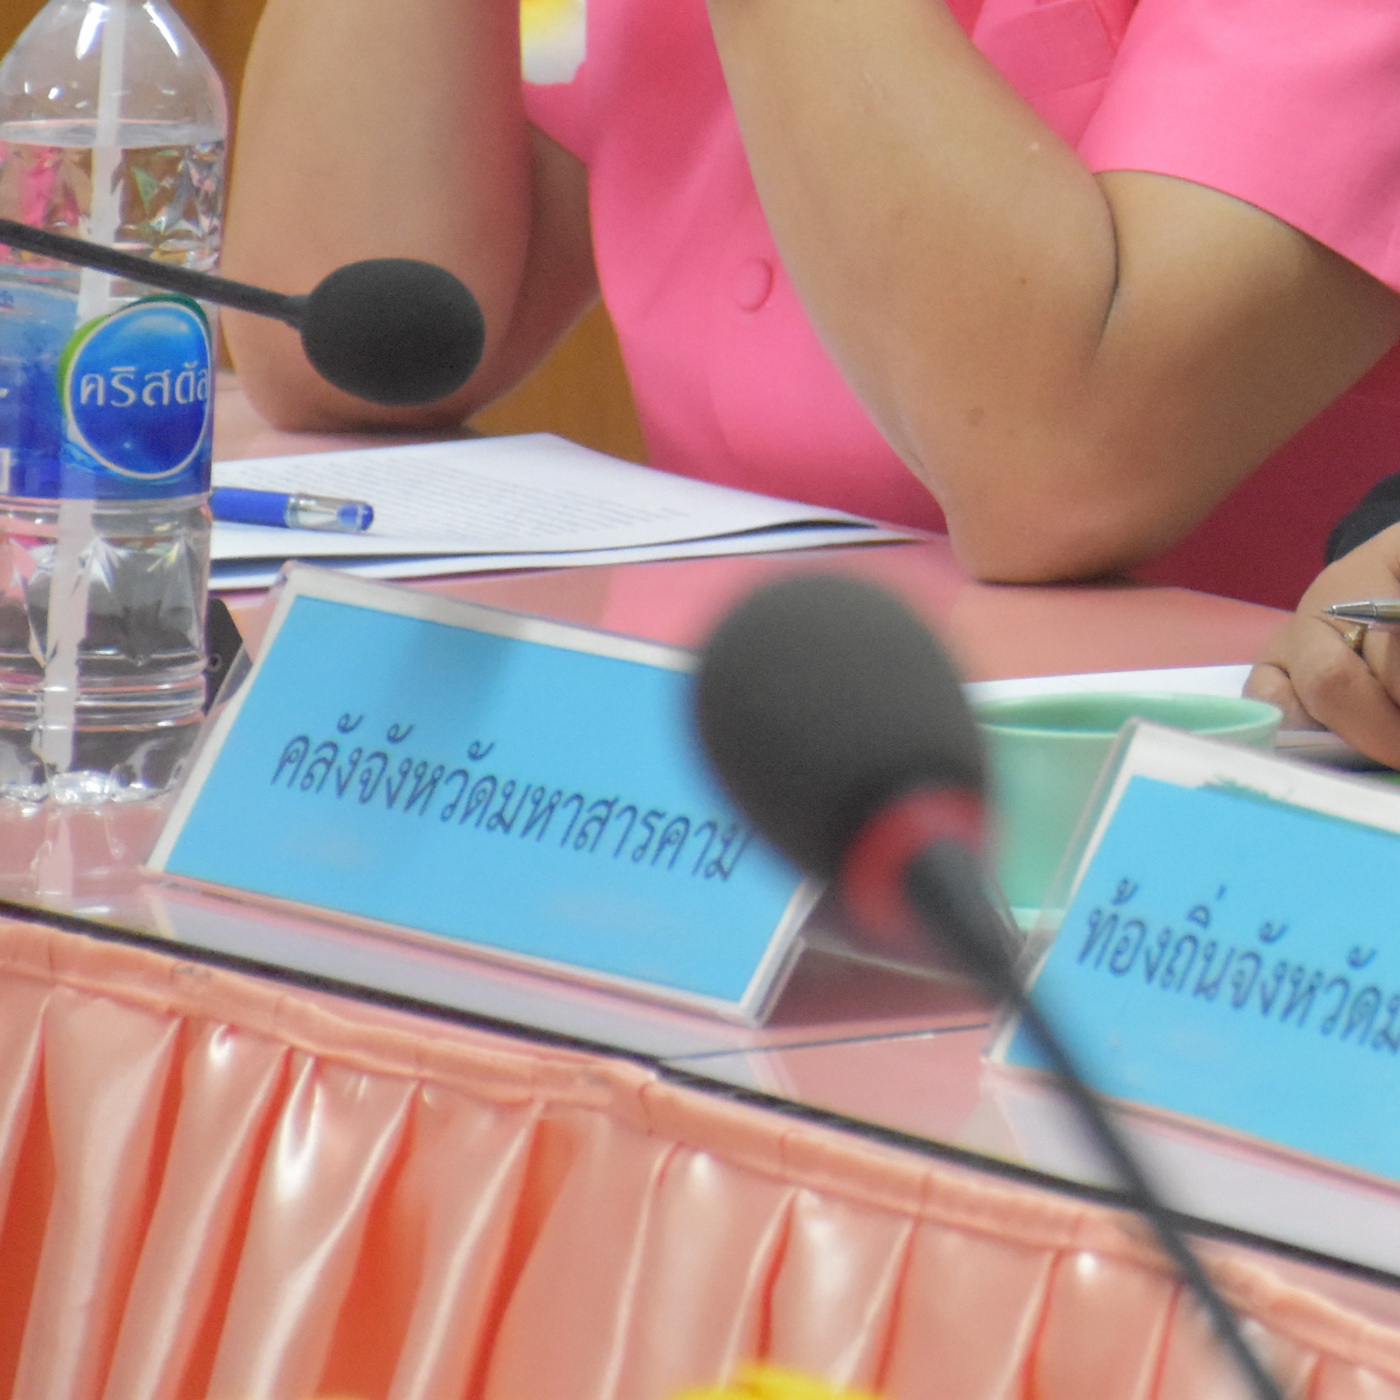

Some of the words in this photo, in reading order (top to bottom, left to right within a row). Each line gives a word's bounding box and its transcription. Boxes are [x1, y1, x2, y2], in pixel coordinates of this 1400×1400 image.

[270, 712, 750, 883] คลังจังหวัดมหาสารคาม
